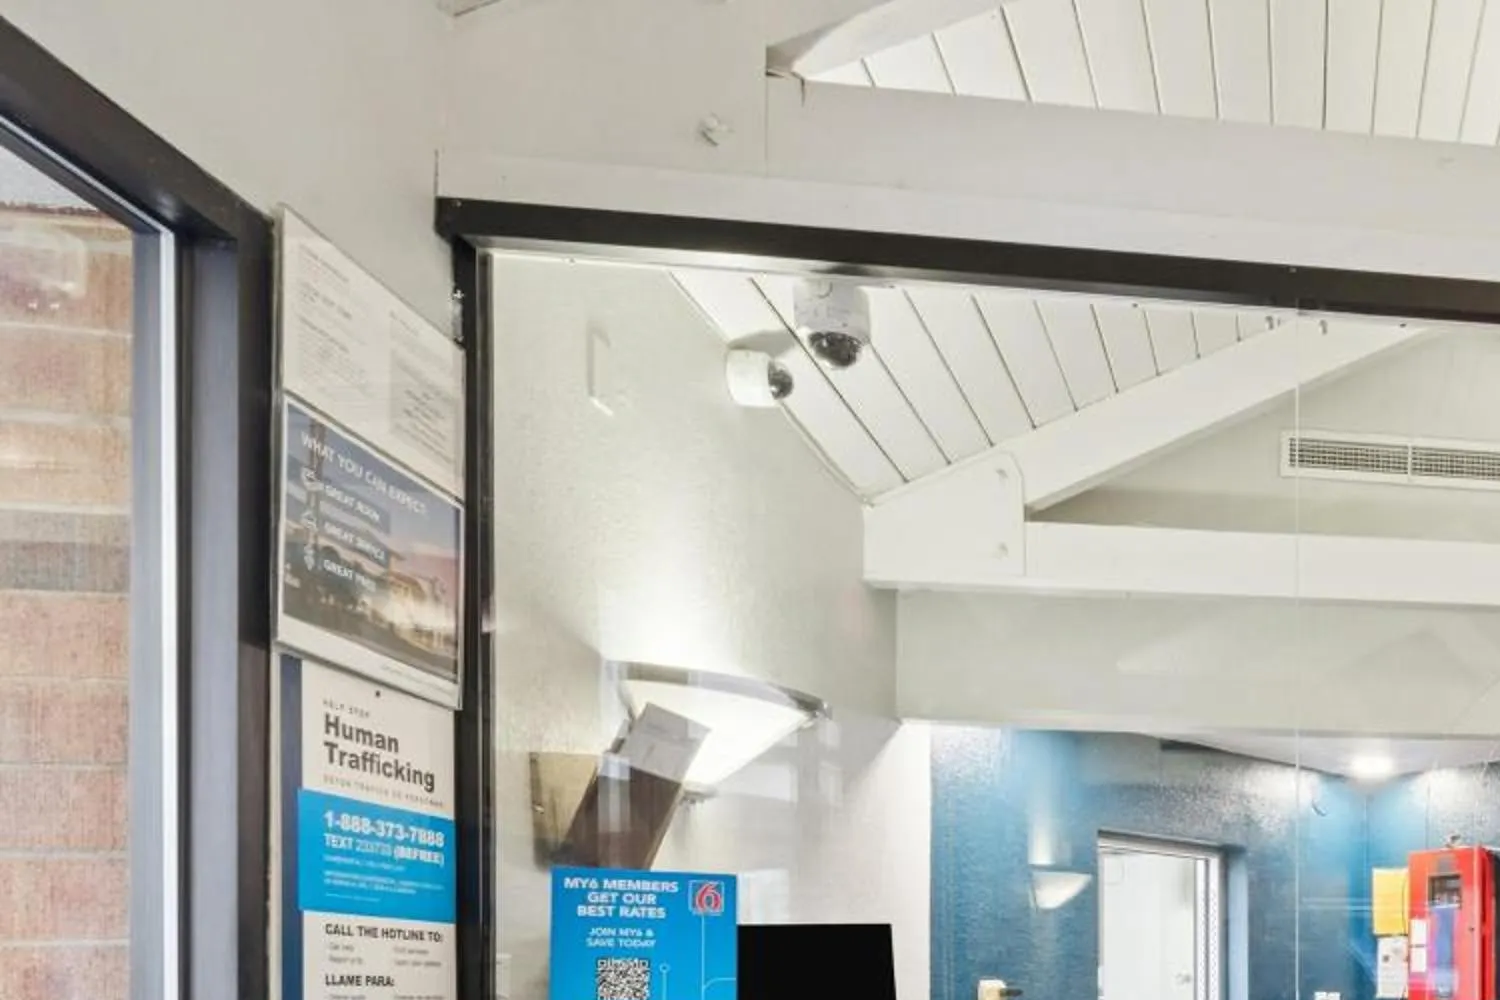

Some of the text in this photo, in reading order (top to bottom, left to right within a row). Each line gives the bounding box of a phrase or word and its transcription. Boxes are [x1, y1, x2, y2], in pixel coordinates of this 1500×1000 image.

[337, 454, 363, 477] YOU
[324, 712, 399, 753] Human
[323, 741, 435, 793] Trafficking
[564, 877, 599, 889] MY6
[587, 891, 657, 905] GET OUR
[694, 881, 722, 914] 6
[577, 905, 666, 919] BEST RATES
[325, 923, 353, 936] CALL
[357, 926, 378, 938] THE
[381, 927, 424, 941] HOTLINE
[325, 973, 362, 987] LLAME
